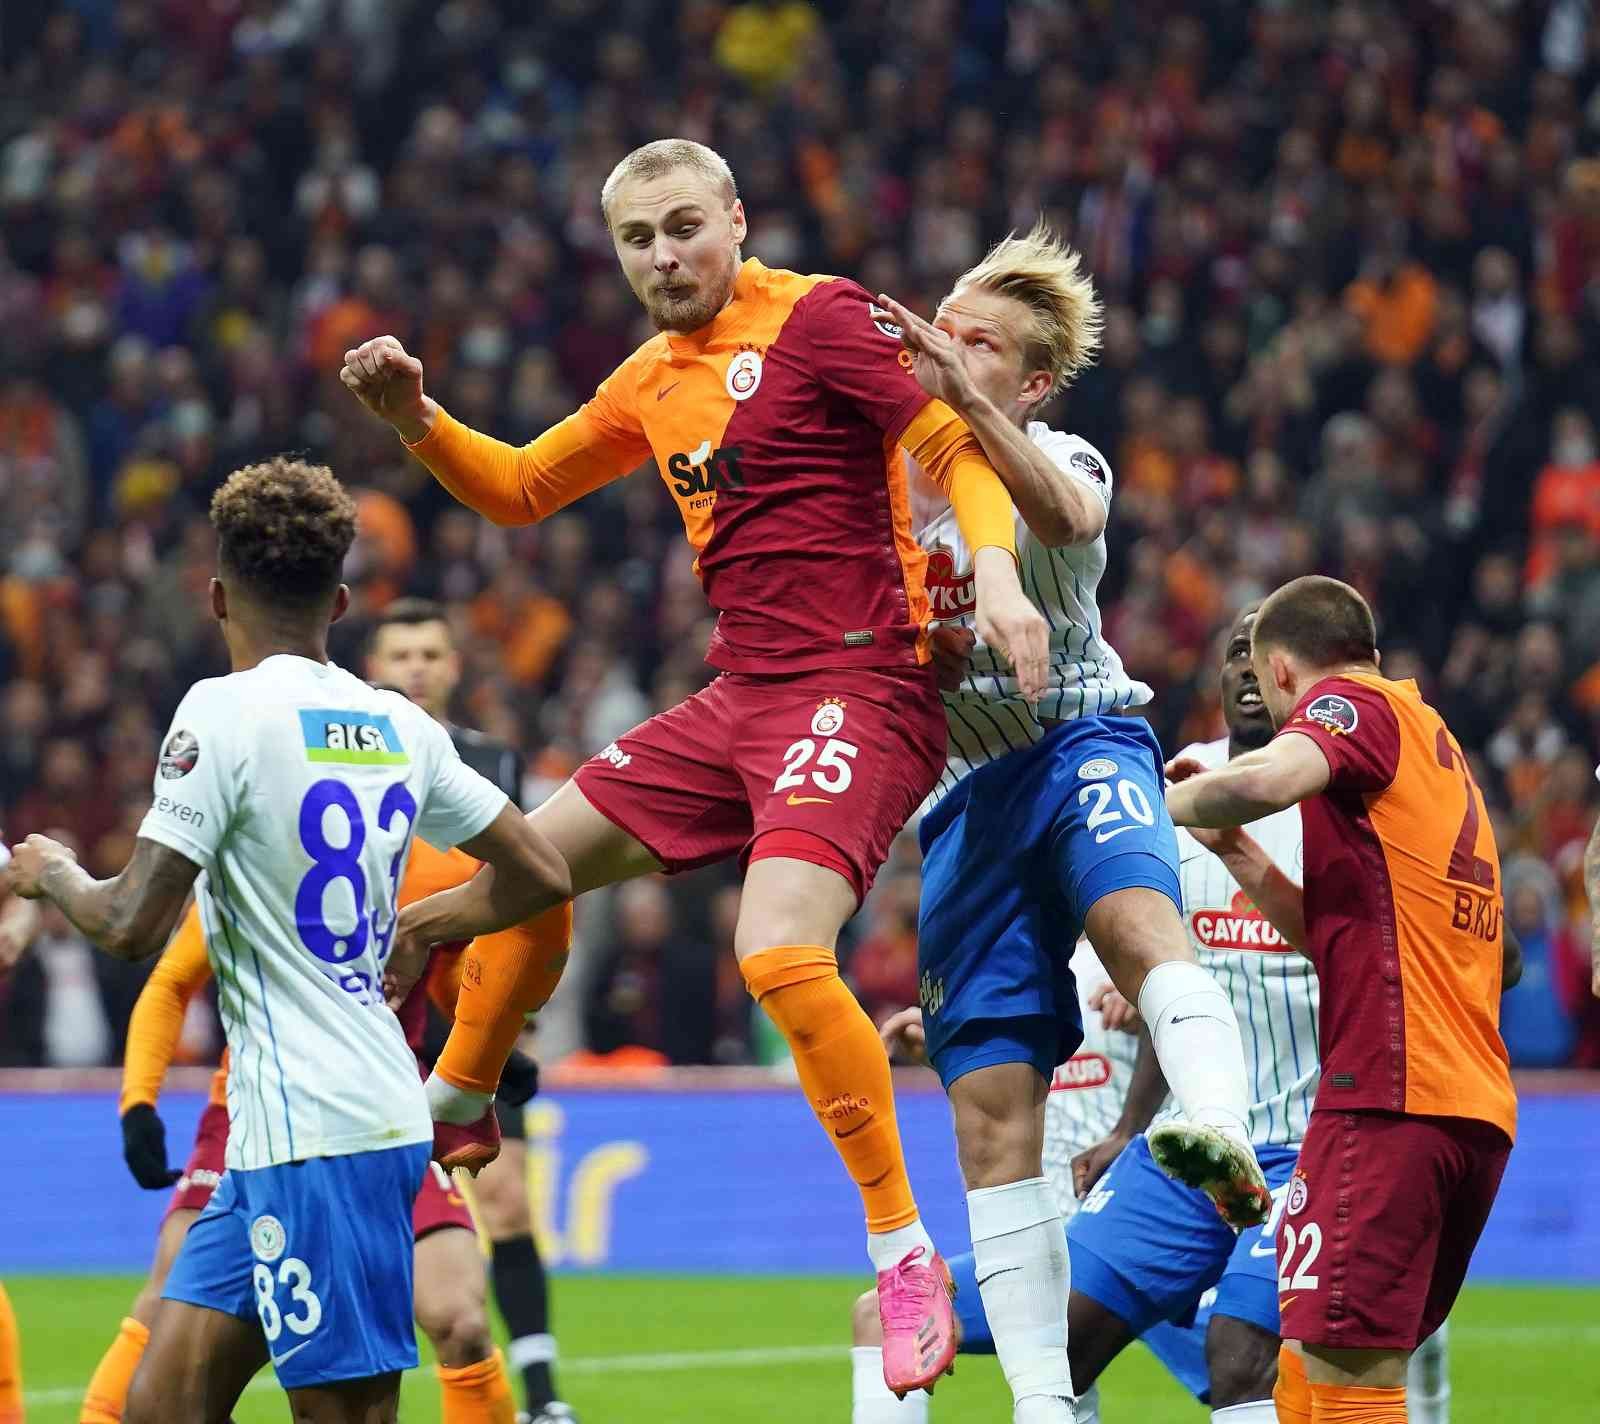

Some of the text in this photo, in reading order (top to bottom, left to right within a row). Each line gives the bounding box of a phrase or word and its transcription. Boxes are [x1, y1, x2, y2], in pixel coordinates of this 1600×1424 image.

[689, 496, 713, 510] rent
[928, 580, 976, 610] YKU
[773, 738, 859, 794] 25
[153, 794, 205, 828] exen
[1078, 779, 1155, 833] 20
[1435, 727, 1495, 891] 2
[1196, 916, 1289, 946] ÇAYKU
[1452, 889, 1503, 943] B.KU
[1053, 1059, 1105, 1083] KUR
[1278, 1221, 1323, 1293] 22
[252, 1257, 322, 1342] 83
